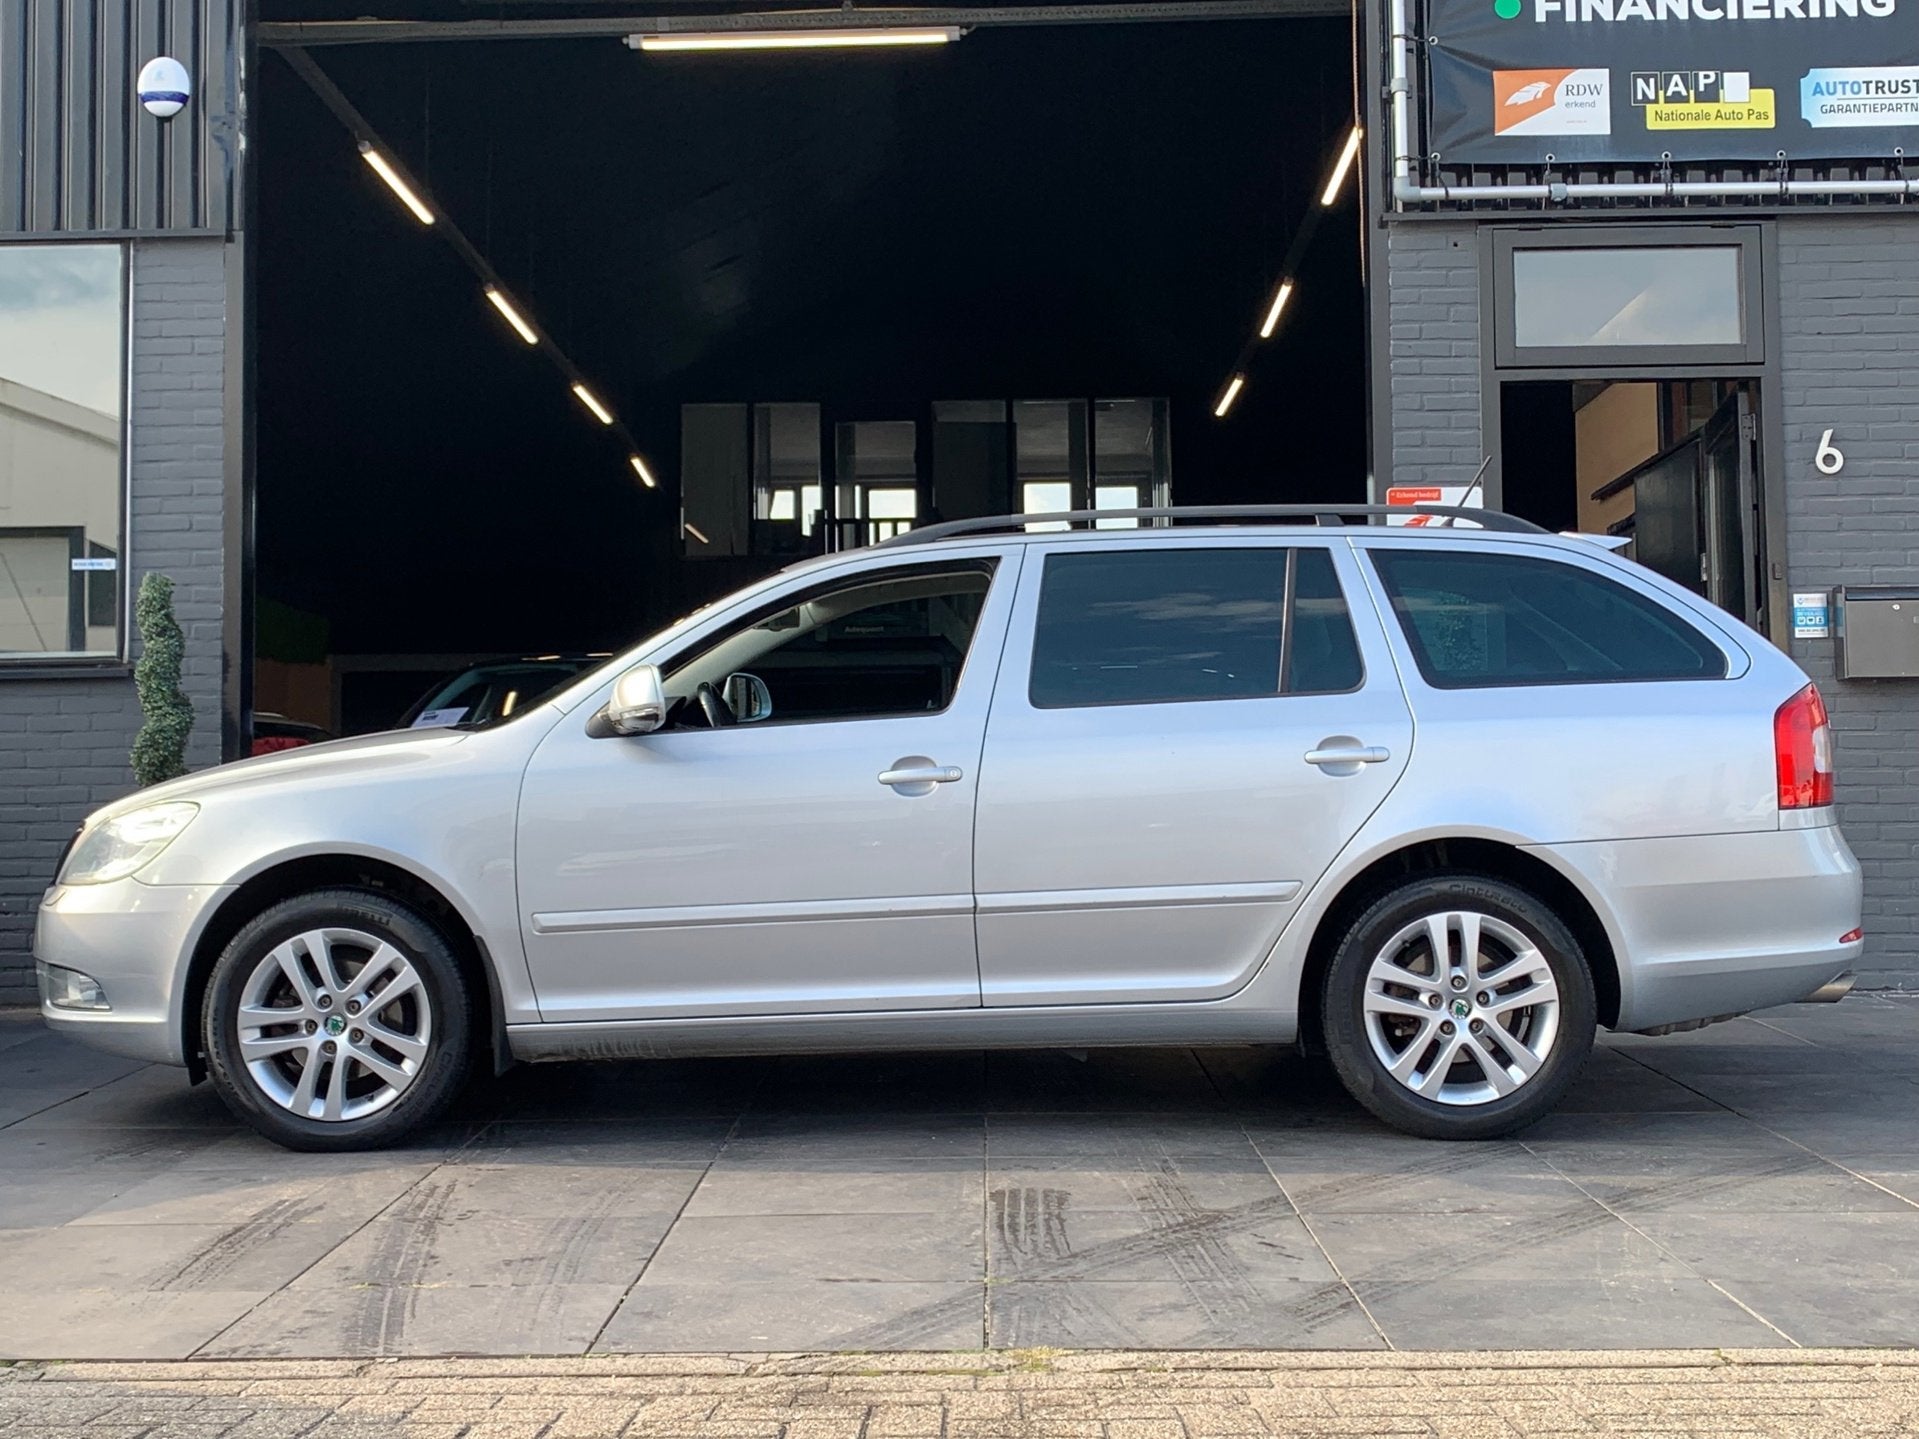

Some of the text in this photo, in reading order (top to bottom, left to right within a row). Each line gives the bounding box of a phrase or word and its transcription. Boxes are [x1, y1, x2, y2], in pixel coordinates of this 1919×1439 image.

[1534, 0, 1897, 22] FINANCIERING
[1565, 83, 1603, 97] RDW
[1636, 71, 1717, 101] NAP
[1811, 79, 1919, 97] AUTOTRUST
[1565, 100, 1596, 109] erkend
[1820, 102, 1919, 114] GARANTIEPARTN
[1654, 108, 1770, 122] Nationale Auto Pas
[1815, 428, 1844, 475] 6
